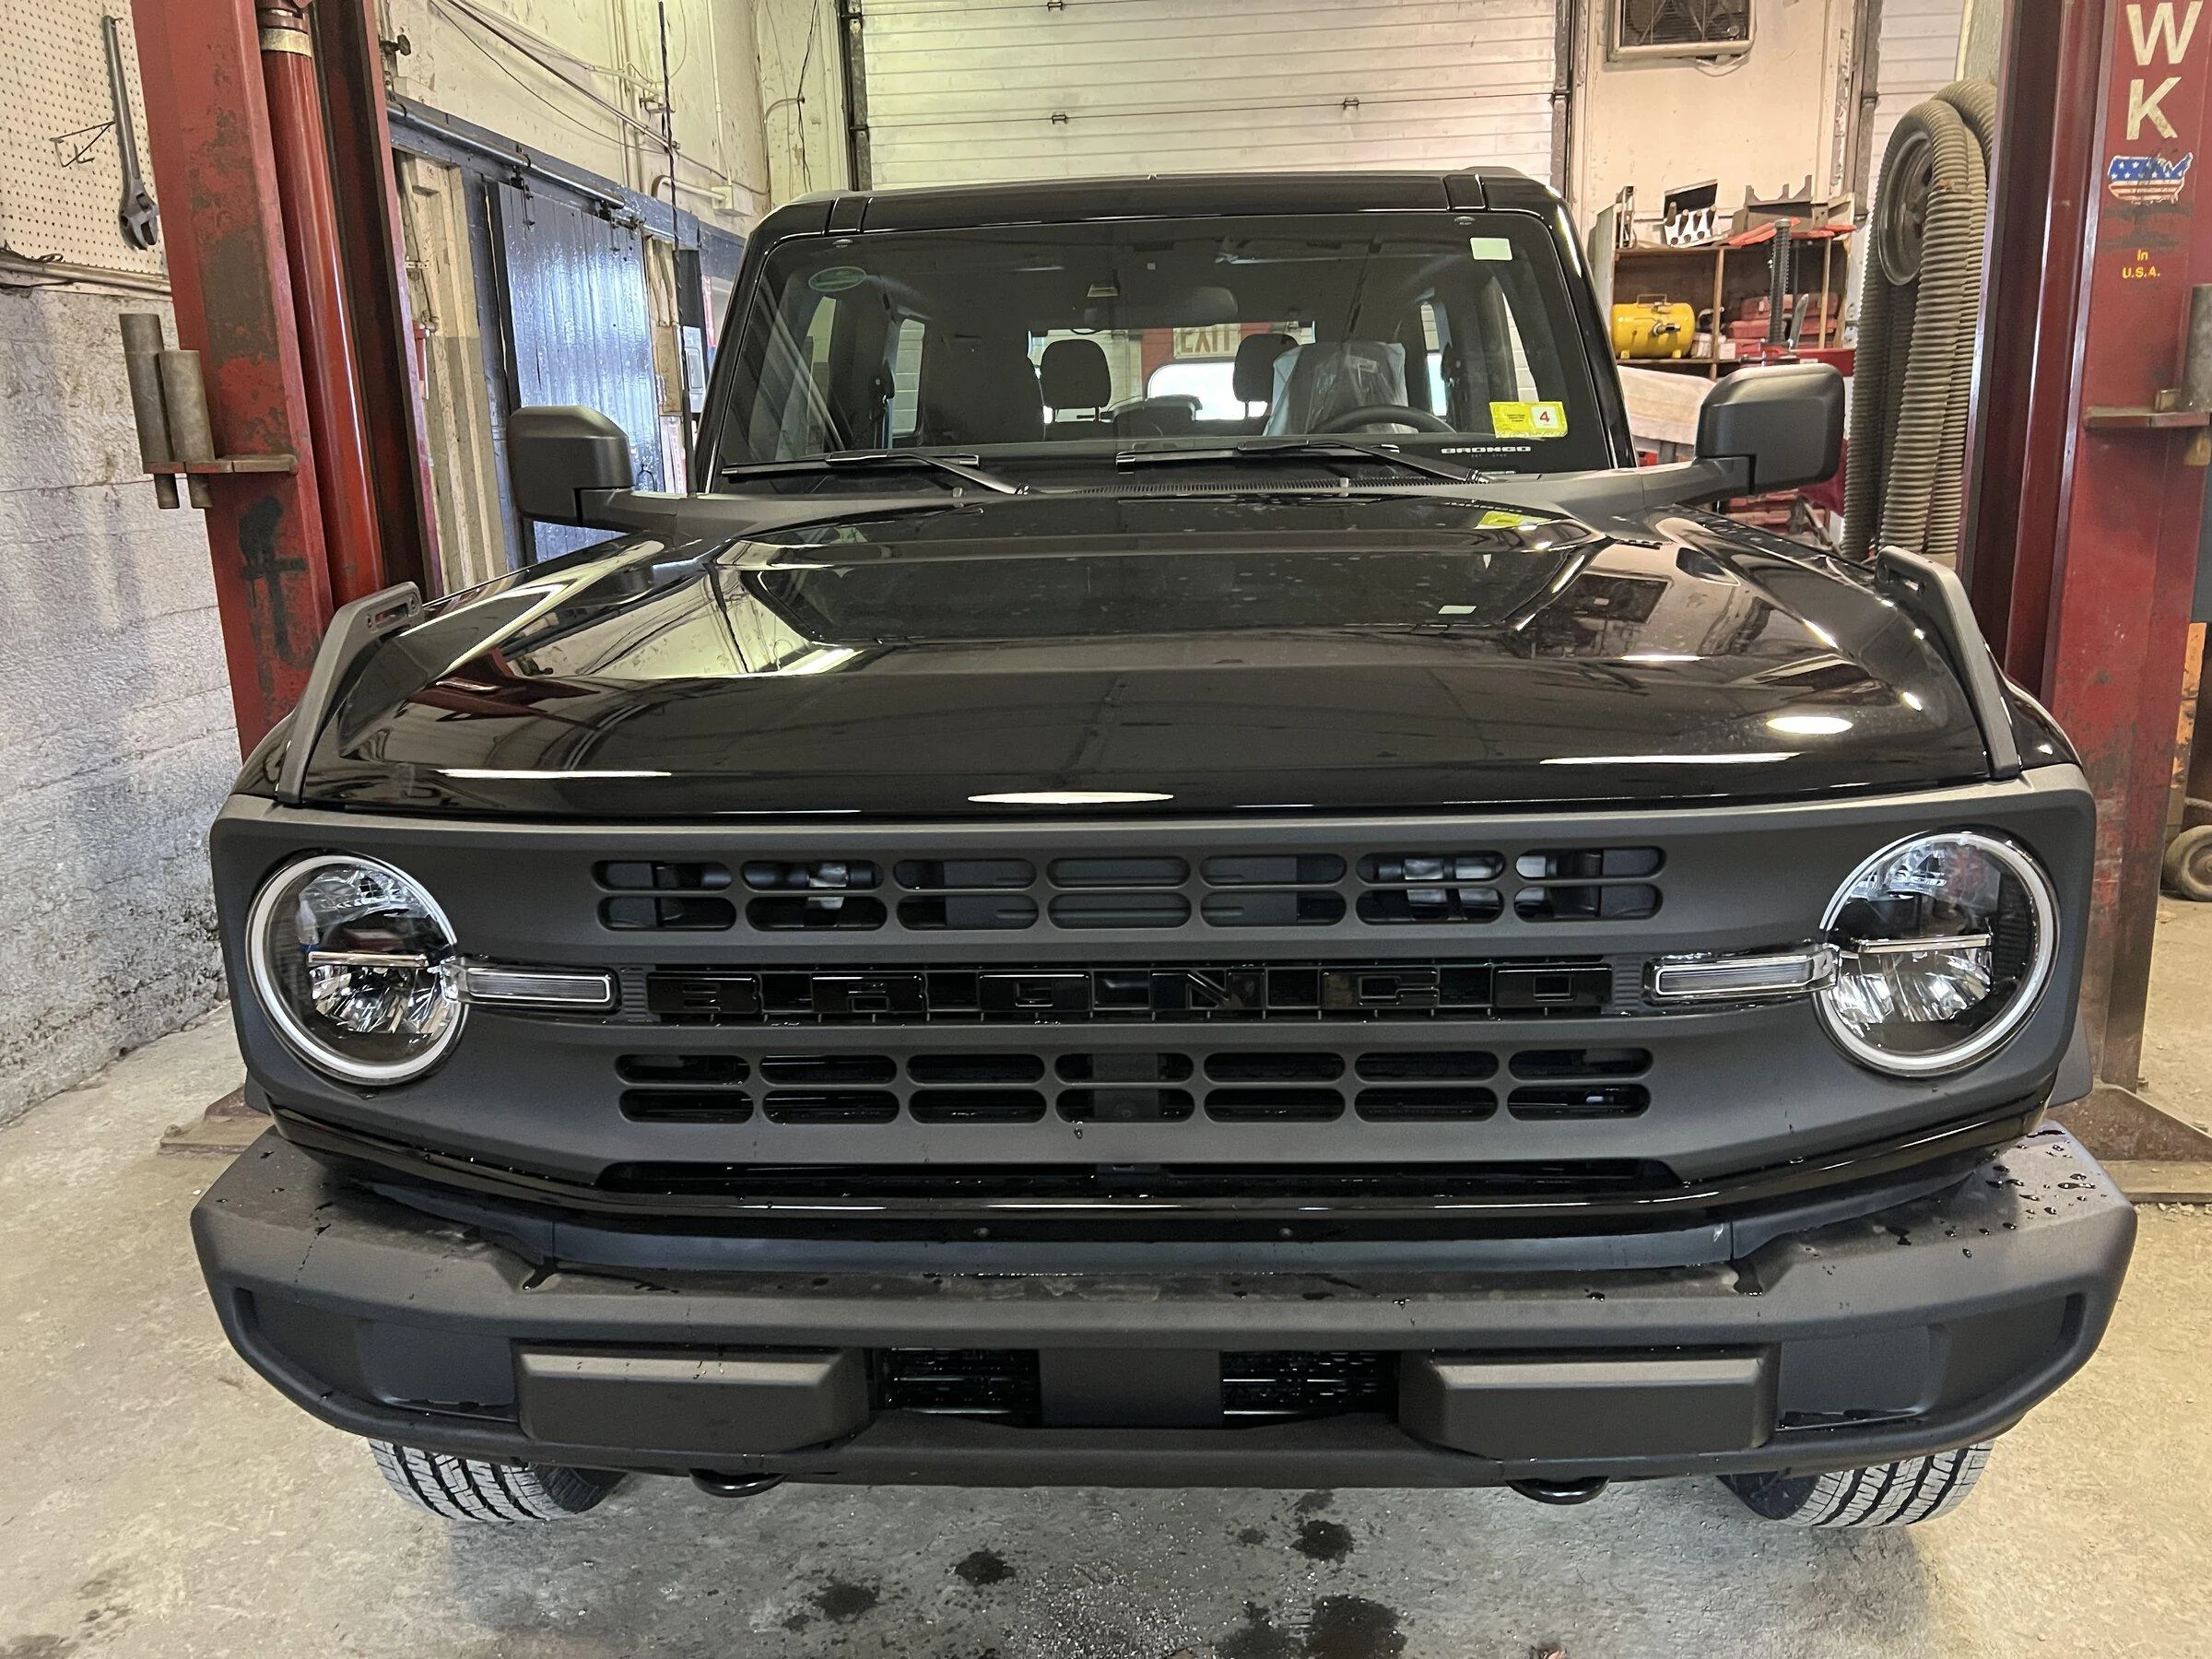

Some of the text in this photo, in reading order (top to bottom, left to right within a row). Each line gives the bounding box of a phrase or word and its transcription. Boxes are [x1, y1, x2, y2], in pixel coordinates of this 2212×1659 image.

[2123, 265, 2160, 278] U.S.A.
[1539, 411, 1550, 422] 4
[646, 967, 1612, 1015] BRONCO
